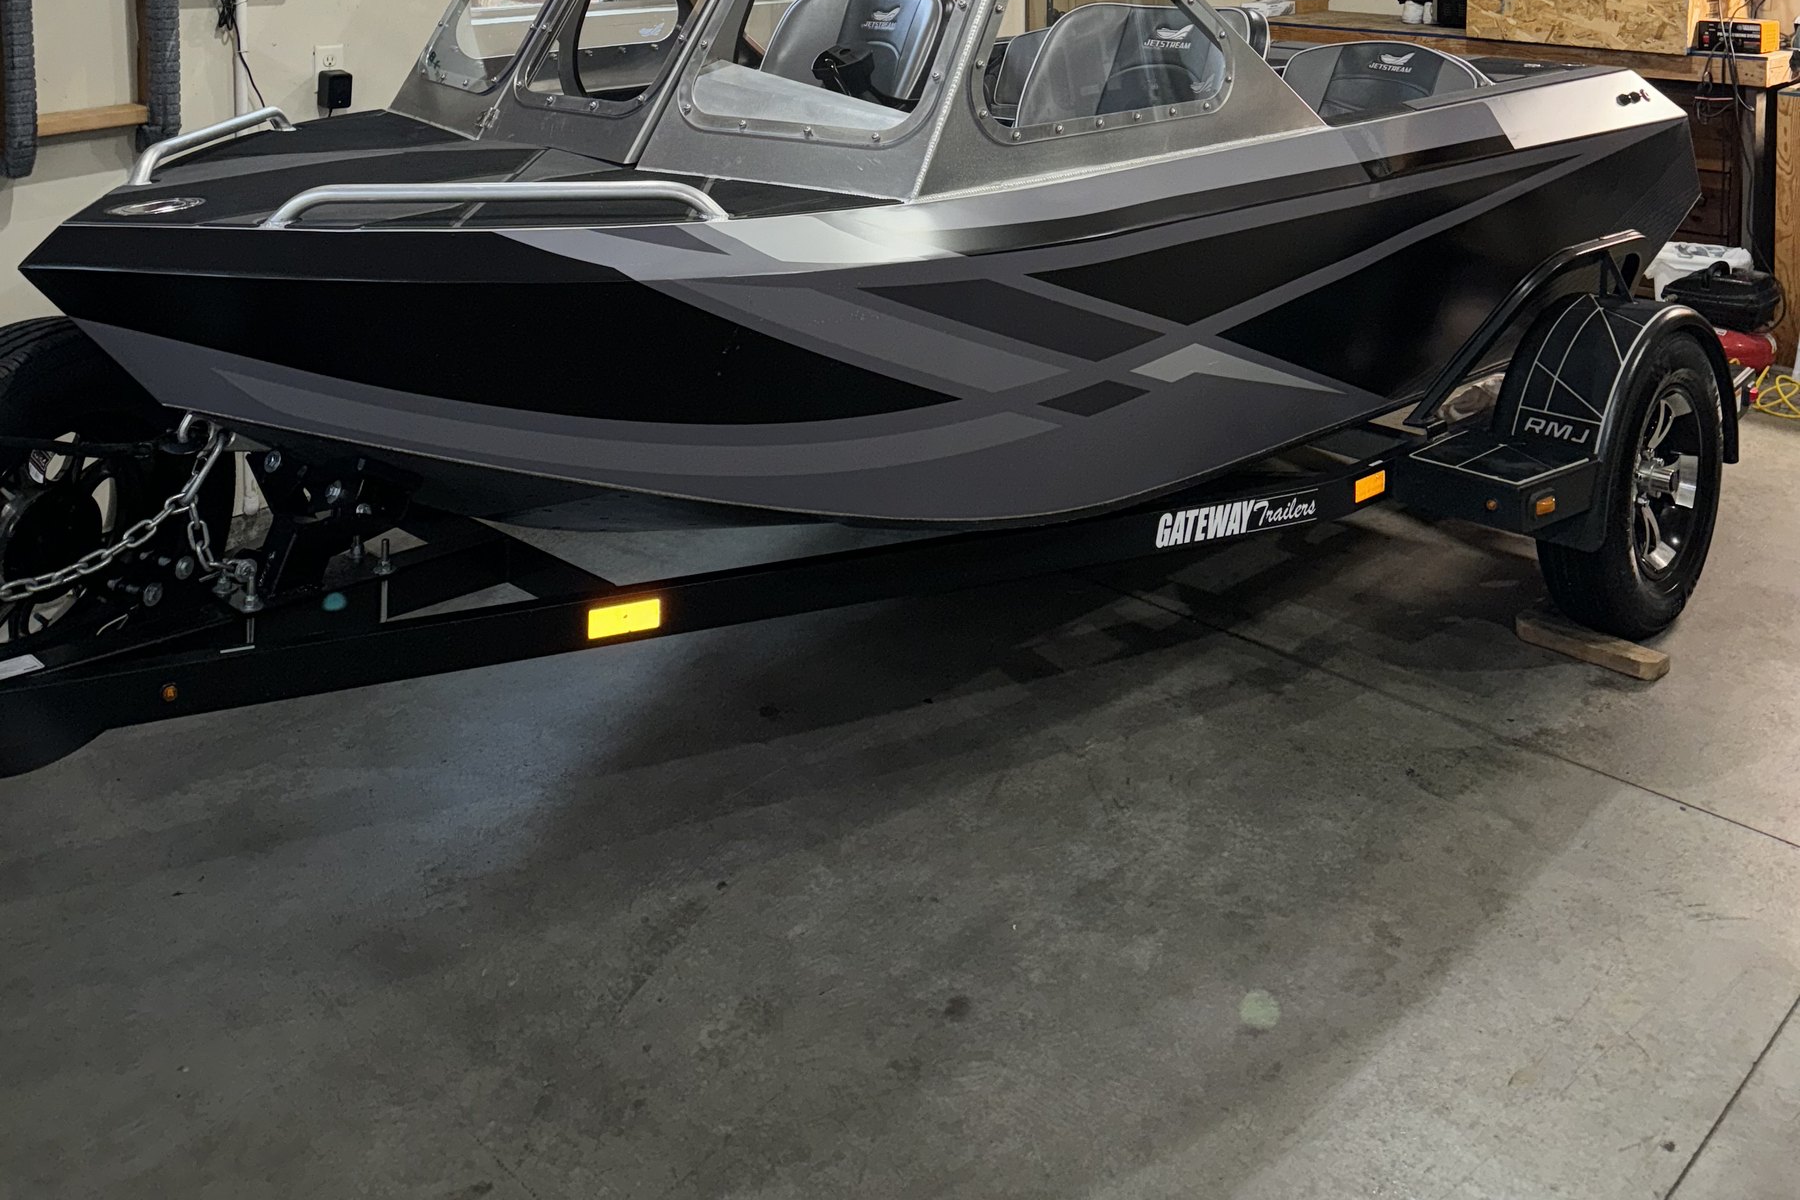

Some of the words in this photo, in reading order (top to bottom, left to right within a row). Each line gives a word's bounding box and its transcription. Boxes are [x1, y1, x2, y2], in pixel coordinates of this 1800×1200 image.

[861, 20, 897, 30] JETSTREAM
[1143, 39, 1191, 49] JETSTREAM
[1368, 62, 1413, 73] JETSTREAM
[1524, 416, 1590, 443] RMJ
[1155, 499, 1255, 549] GATEWAY
[1253, 497, 1317, 526] Trailers
